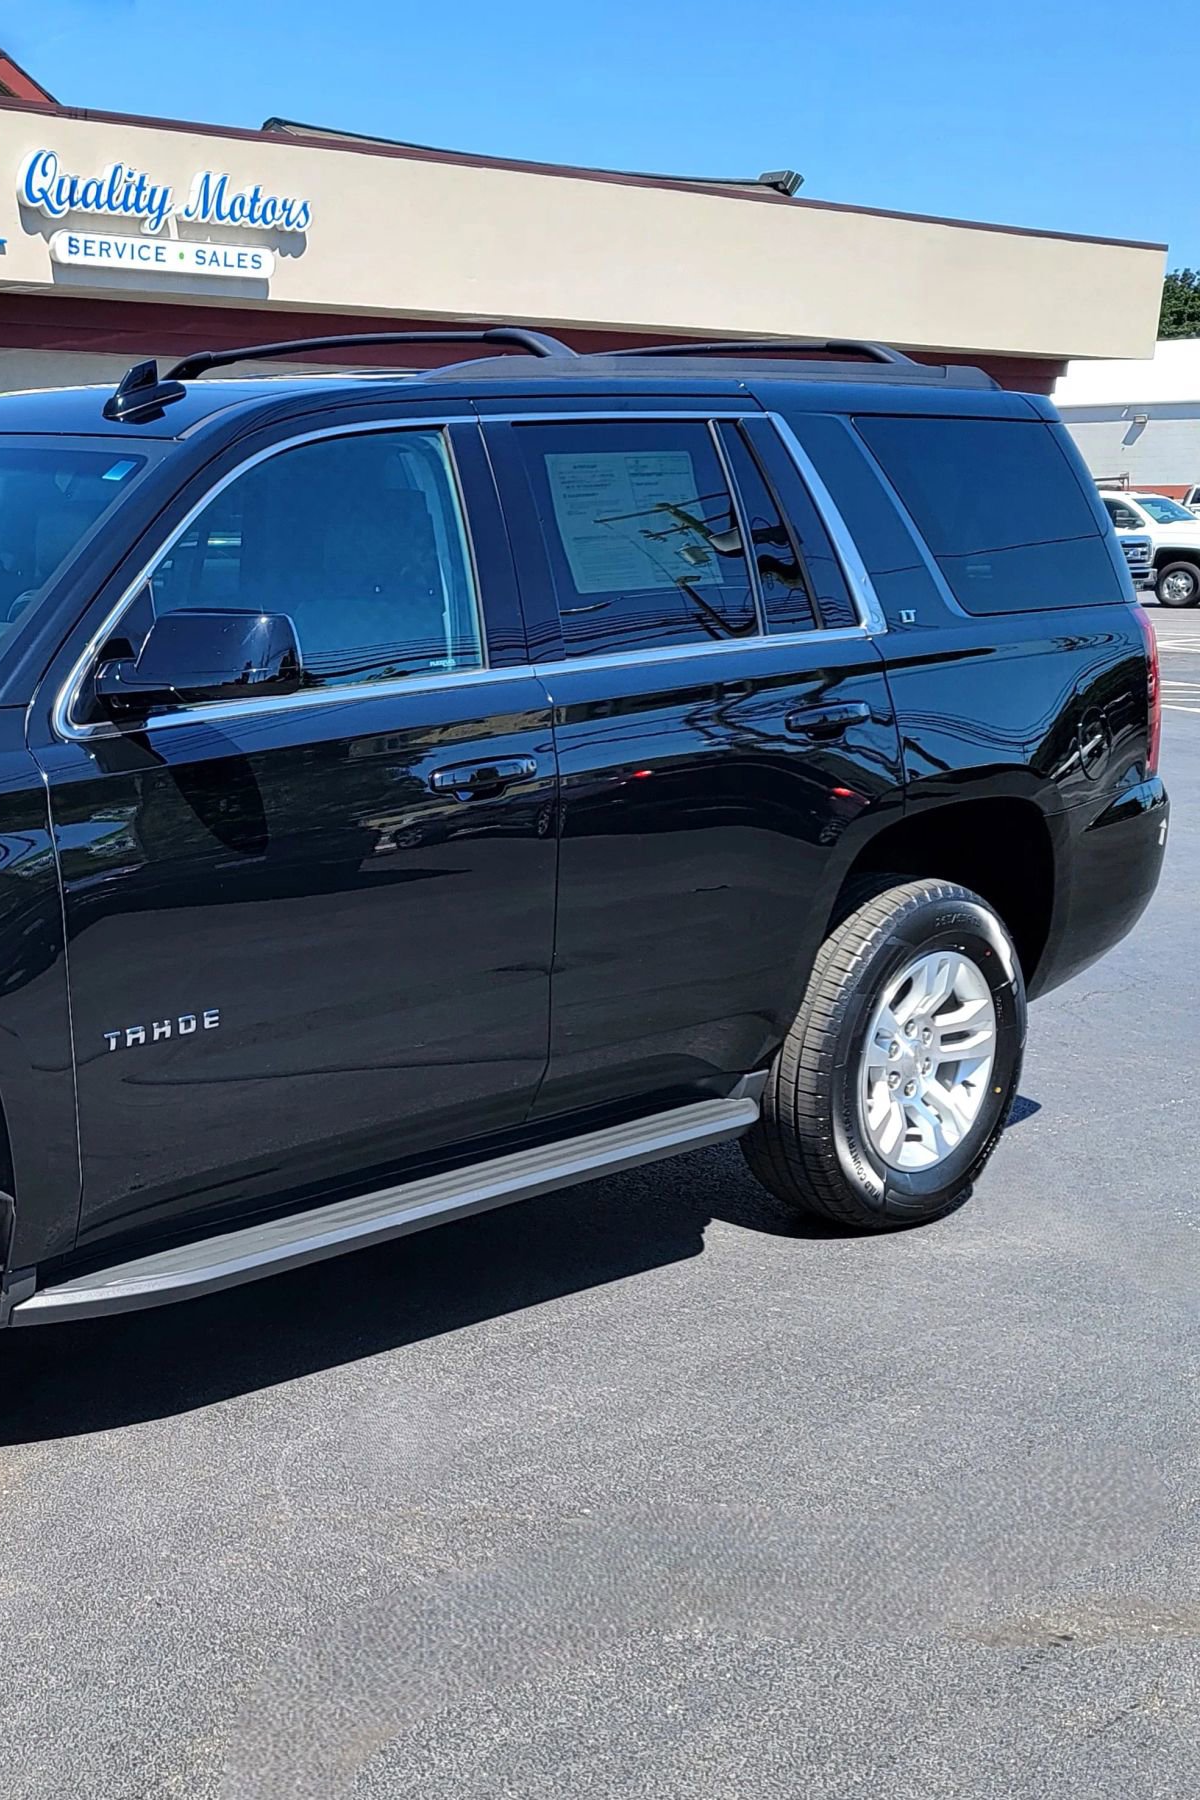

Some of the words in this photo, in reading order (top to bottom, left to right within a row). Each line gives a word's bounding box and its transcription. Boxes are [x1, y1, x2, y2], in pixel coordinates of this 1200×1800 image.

[23, 150, 172, 231] Quality
[186, 171, 311, 229] Motors
[67, 236, 167, 263] SERVICE
[195, 249, 263, 270] SALES
[103, 1009, 219, 1051] TAHOE
